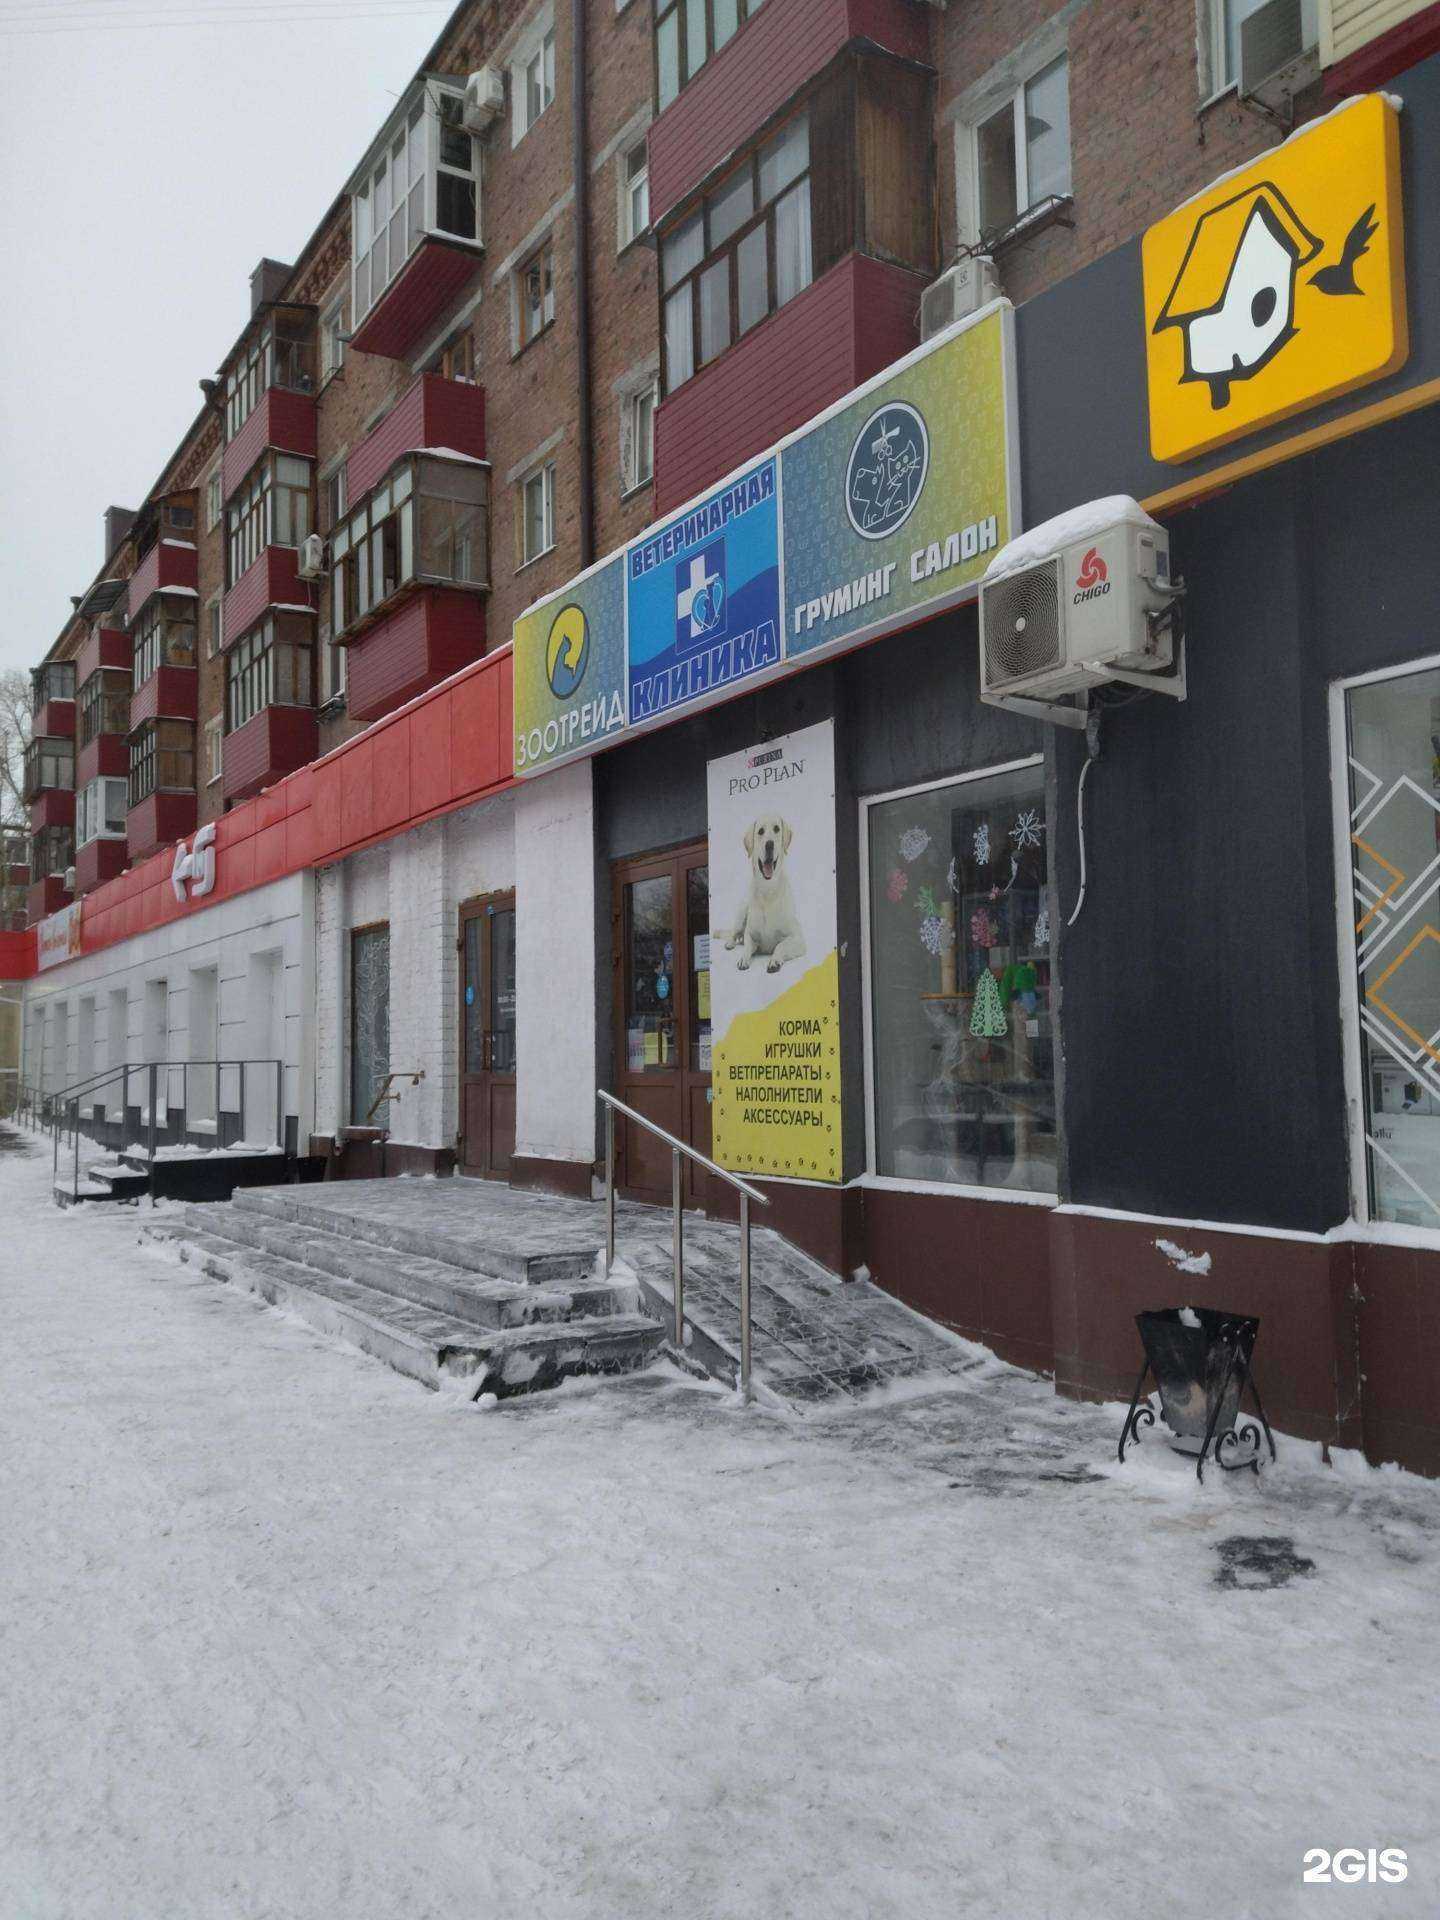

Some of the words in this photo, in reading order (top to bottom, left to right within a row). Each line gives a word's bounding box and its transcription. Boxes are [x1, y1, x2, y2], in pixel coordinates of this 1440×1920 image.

[631, 462, 776, 581] ВЕТЕРИНАРНАЯ
[794, 561, 897, 634] ГРУМИНГ
[910, 514, 998, 583] САЛОН
[1073, 582, 1111, 605] CHIGO
[632, 619, 778, 720] КЛИНИКА
[517, 690, 625, 766] ЗООТРЕЙД
[729, 775, 760, 795] PRO
[779, 1020, 821, 1036] КОРМА
[765, 1043, 822, 1058] ИГРУШКИ
[729, 1065, 822, 1081] ВЕТПРЕПАРАТЫ
[736, 1086, 823, 1103] НАПОЛНИТЕЛИ
[743, 1108, 823, 1127] АКСЕССУАРЫ
